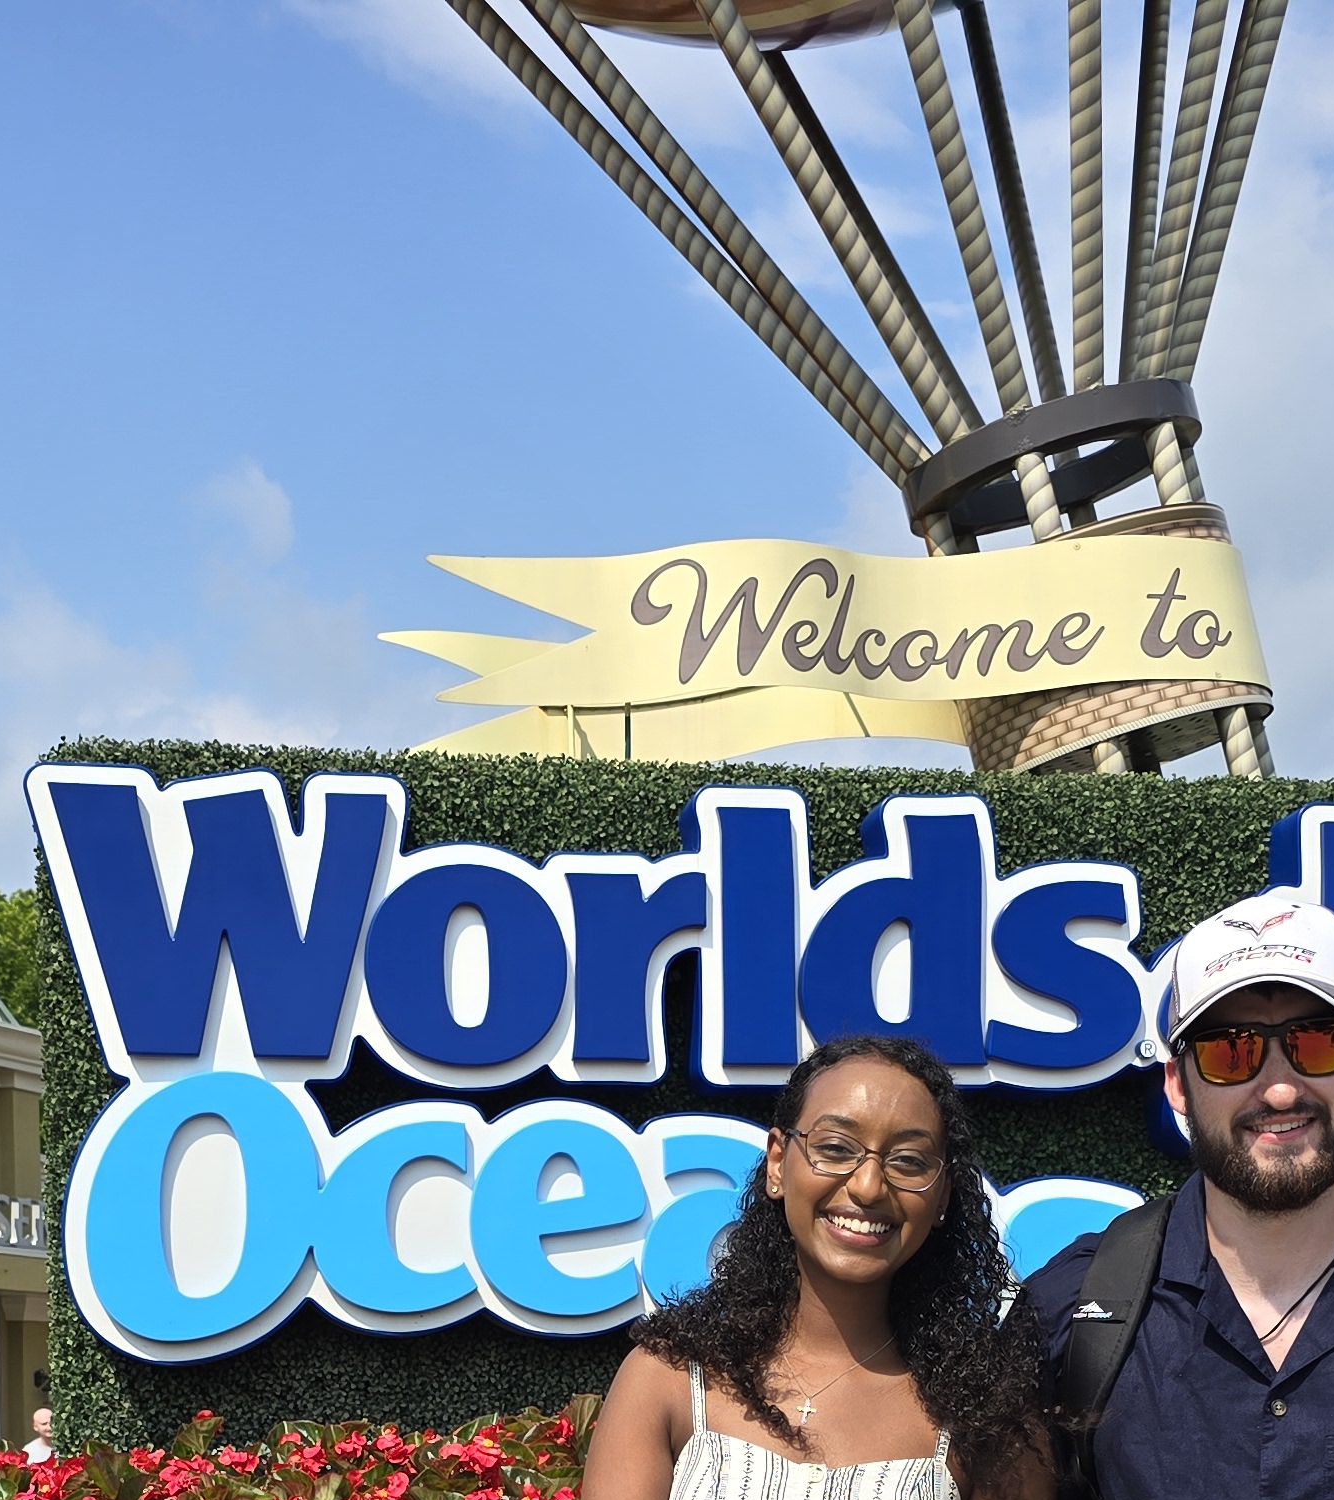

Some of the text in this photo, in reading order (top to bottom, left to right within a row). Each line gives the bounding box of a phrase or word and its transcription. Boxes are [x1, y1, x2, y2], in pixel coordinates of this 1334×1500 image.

[630, 557, 1233, 685] Welcome to
[1202, 951, 1313, 978] RACING
[1204, 944, 1317, 972] CORVETTE
[84, 1070, 1141, 1343] Ocea
